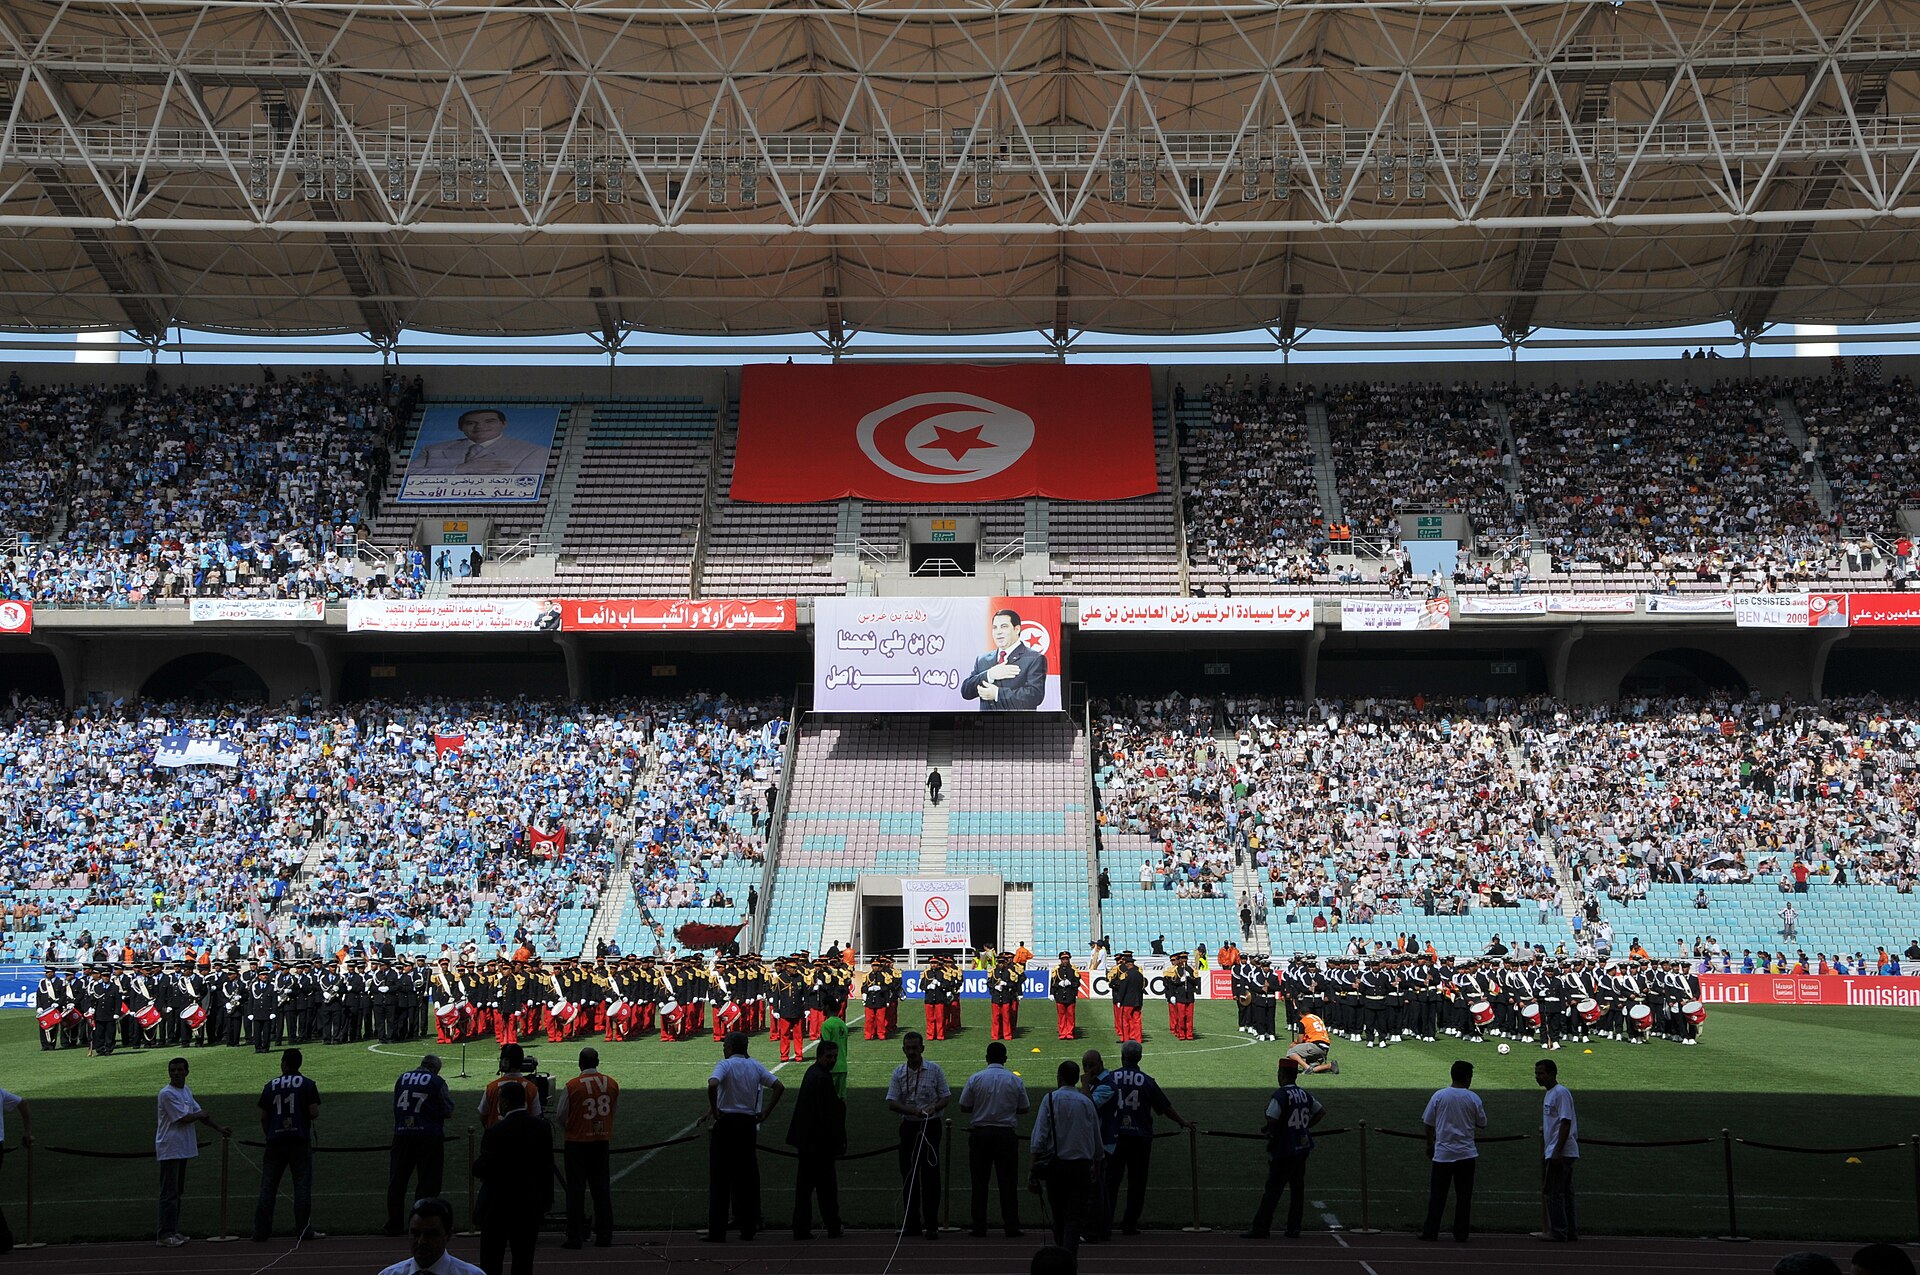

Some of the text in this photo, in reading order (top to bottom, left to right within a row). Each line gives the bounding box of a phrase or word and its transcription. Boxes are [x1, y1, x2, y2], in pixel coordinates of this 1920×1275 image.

[453, 522, 458, 531] 2
[1427, 518, 1433, 526] 3
[1735, 596, 1749, 605] Les
[577, 606, 617, 625] دائما
[726, 605, 785, 628] تونس
[858, 609, 927, 624] ولاية بن عروس
[1081, 604, 1310, 626] مرحبا بسيادة الرئيس زين العابدين بن علي
[1738, 611, 1808, 624] BEN ALI 2009
[1852, 608, 1872, 625] علي
[1873, 611, 1885, 621] بن
[879, 630, 906, 658] علي
[908, 631, 926, 656] بن
[927, 634, 945, 654] مع
[271, 1075, 303, 1091] PHO
[401, 1072, 432, 1086] PHO
[579, 1075, 608, 1095] TV
[1114, 1070, 1145, 1087] PHO
[272, 1092, 295, 1115] 11
[396, 1089, 429, 1113] 47
[582, 1094, 611, 1120] 38
[1287, 1107, 1310, 1130] 46
